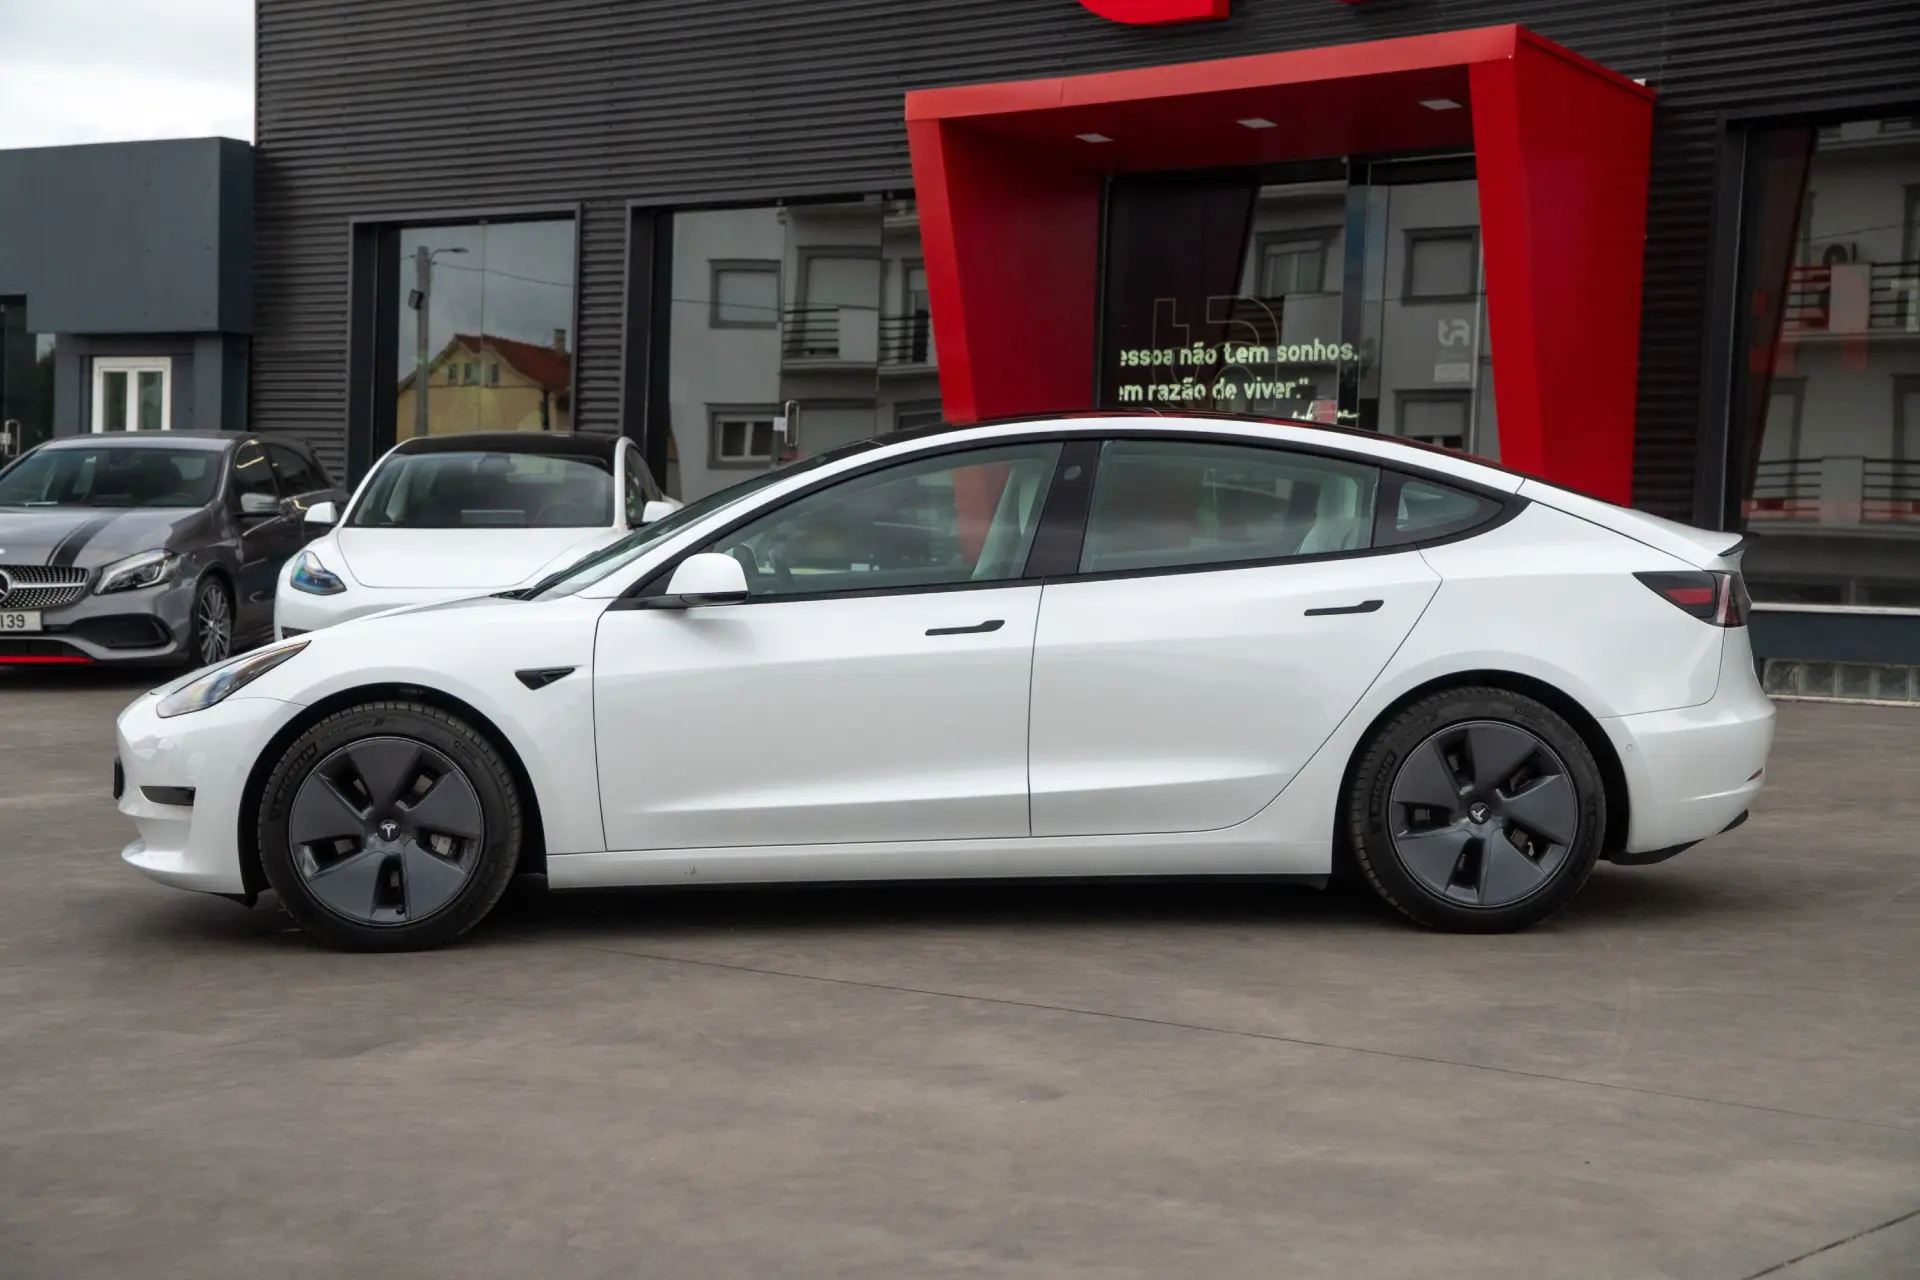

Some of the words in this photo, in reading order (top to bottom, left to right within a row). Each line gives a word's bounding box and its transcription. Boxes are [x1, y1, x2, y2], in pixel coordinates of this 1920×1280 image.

[1180, 341, 1217, 366] não
[1223, 343, 1269, 364] tem
[1276, 338, 1359, 362] sonhos.
[1148, 377, 1207, 401] razão
[1212, 377, 1237, 400] de
